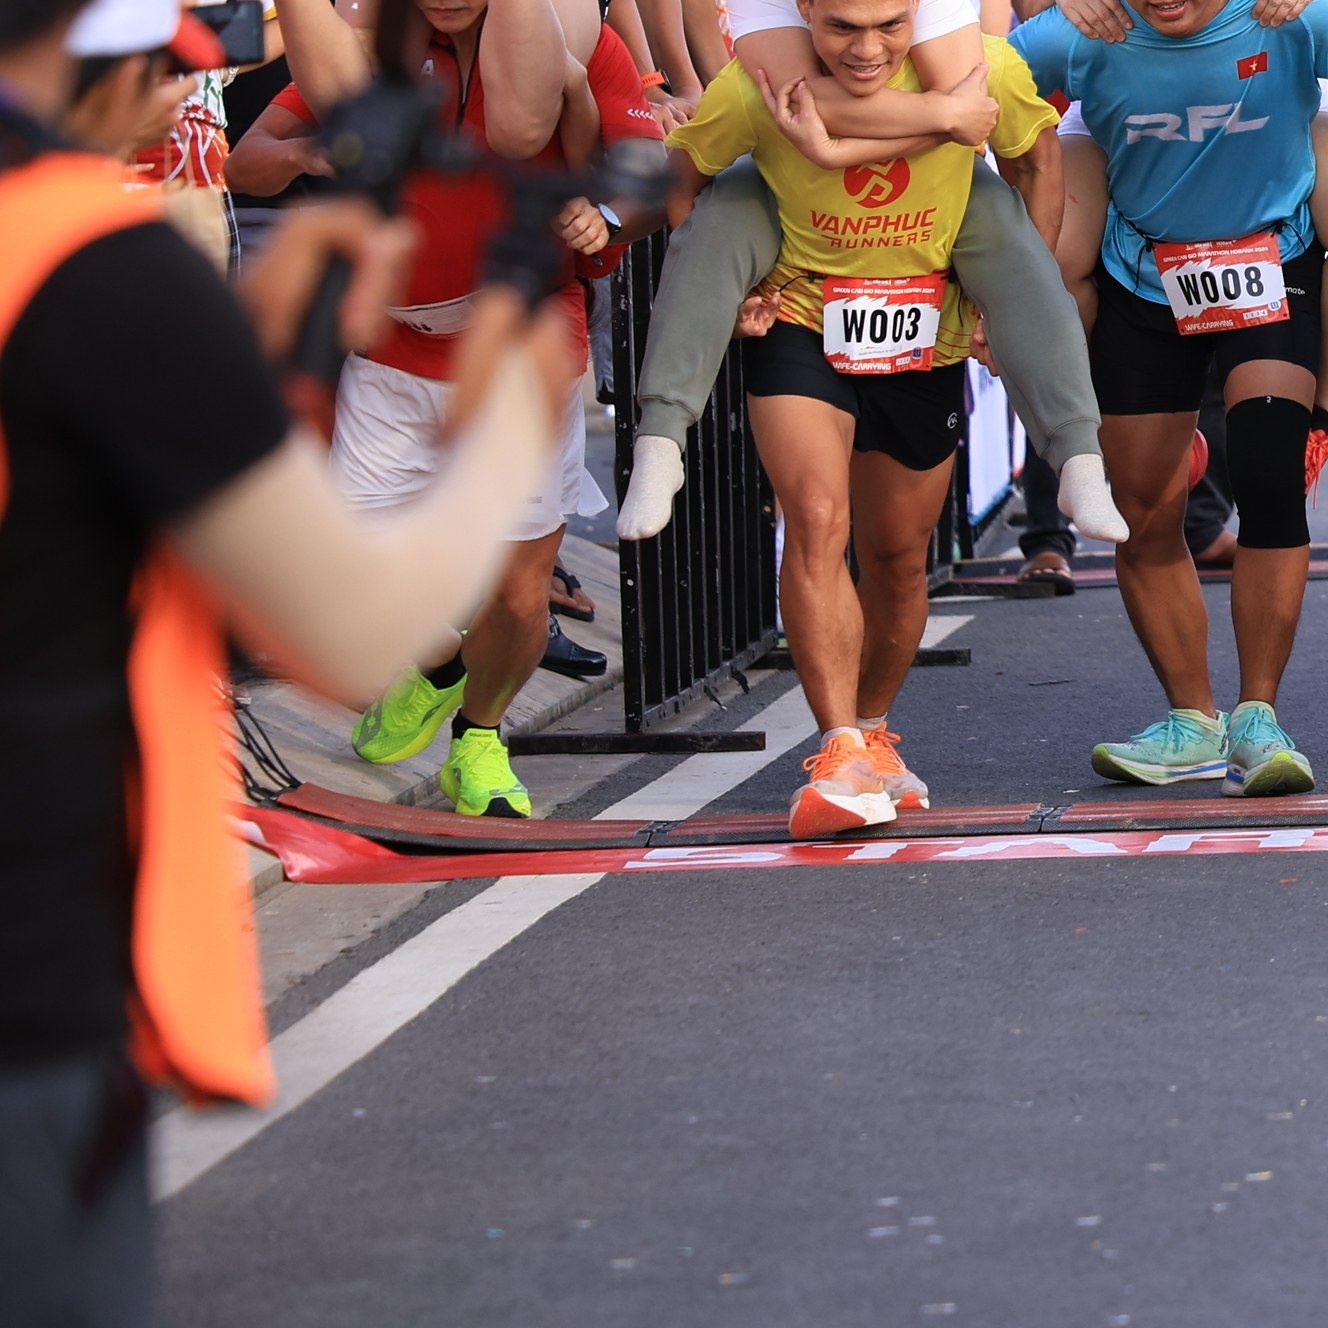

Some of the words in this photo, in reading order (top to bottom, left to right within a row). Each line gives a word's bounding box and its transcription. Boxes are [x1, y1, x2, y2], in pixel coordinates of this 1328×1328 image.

[1125, 101, 1270, 144] RFL
[811, 207, 937, 235] VANPHUC
[821, 230, 931, 249] RUNNERS
[1198, 250, 1229, 258] MARATHON
[1176, 266, 1264, 306] W008
[843, 307, 921, 343] W003
[1185, 320, 1233, 331] WIFE-CARRYING
[833, 361, 891, 371] WIFE-CARRYING
